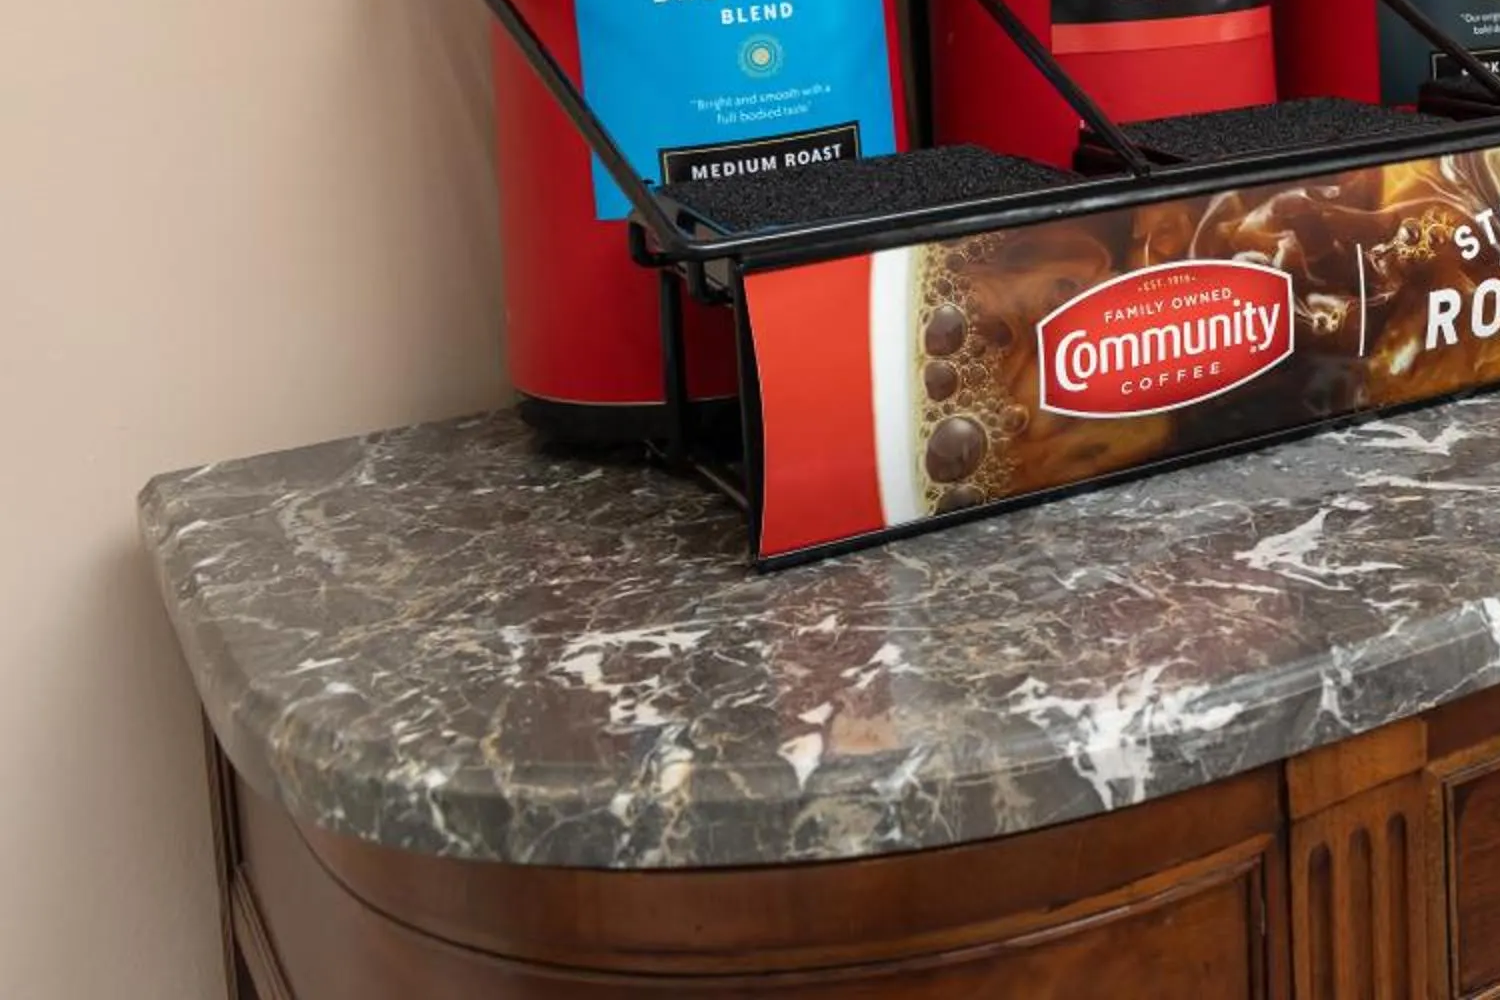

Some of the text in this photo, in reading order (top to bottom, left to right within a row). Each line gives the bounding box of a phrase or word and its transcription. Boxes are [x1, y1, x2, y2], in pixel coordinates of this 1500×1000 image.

[721, 2, 794, 25] BLEND
[735, 94, 757, 106] and
[691, 144, 844, 181] MEDIUM ROAST
[1104, 287, 1232, 323] FAMILY OWNED
[1055, 299, 1280, 392] Community
[1121, 361, 1222, 395] COFFEE
